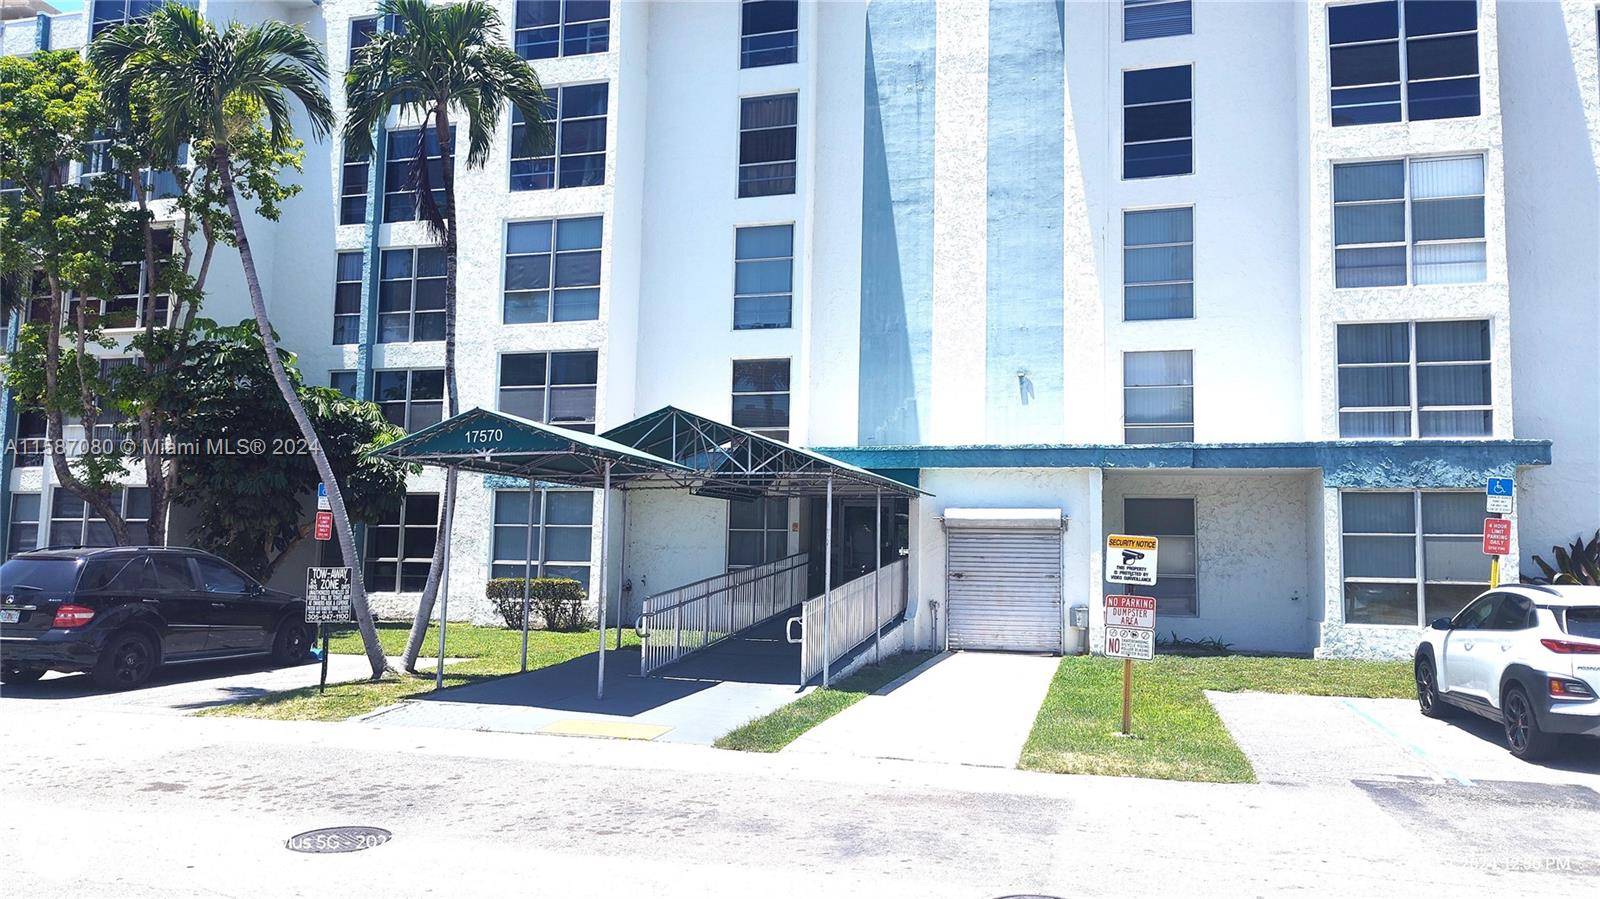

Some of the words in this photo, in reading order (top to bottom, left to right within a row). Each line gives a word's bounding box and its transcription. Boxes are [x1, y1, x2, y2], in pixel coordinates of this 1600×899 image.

[465, 429, 503, 443] 17570
[1108, 538, 1136, 547] SECURITY
[1136, 540, 1156, 549] NOTICE
[312, 568, 348, 579] TOW-AWAY
[320, 579, 340, 590] ZONE
[1108, 597, 1118, 606] NO
[1121, 598, 1154, 609] PARKING
[1112, 607, 1148, 618] DUMPSTER
[1120, 616, 1139, 625] AREA
[1108, 638, 1120, 654] NO
